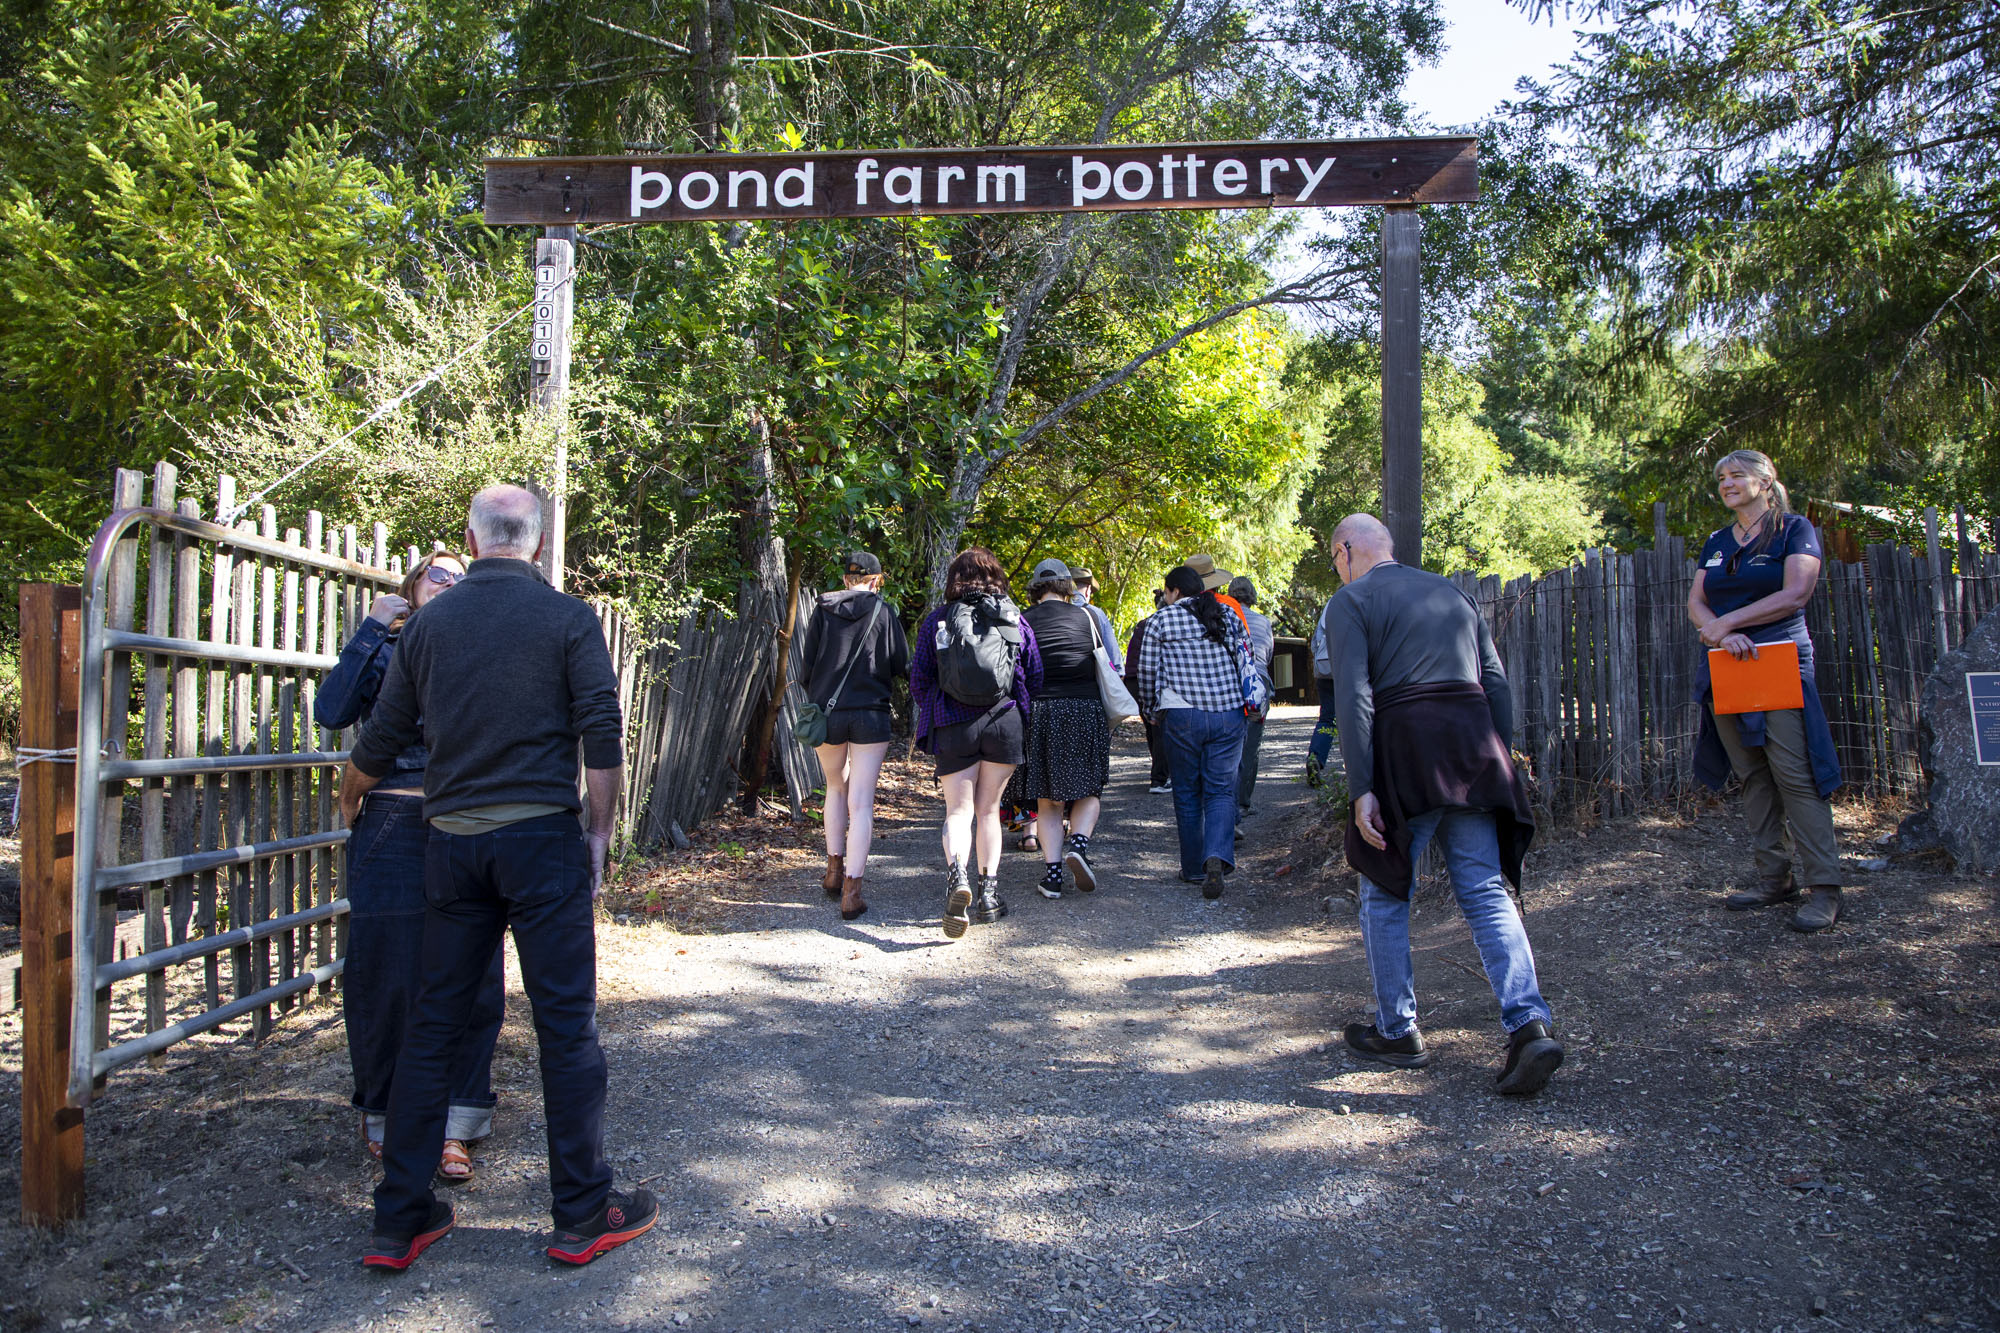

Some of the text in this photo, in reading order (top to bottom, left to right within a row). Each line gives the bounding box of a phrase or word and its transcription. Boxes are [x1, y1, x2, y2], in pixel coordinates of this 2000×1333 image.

[631, 153, 1336, 217] pond farm pottery
